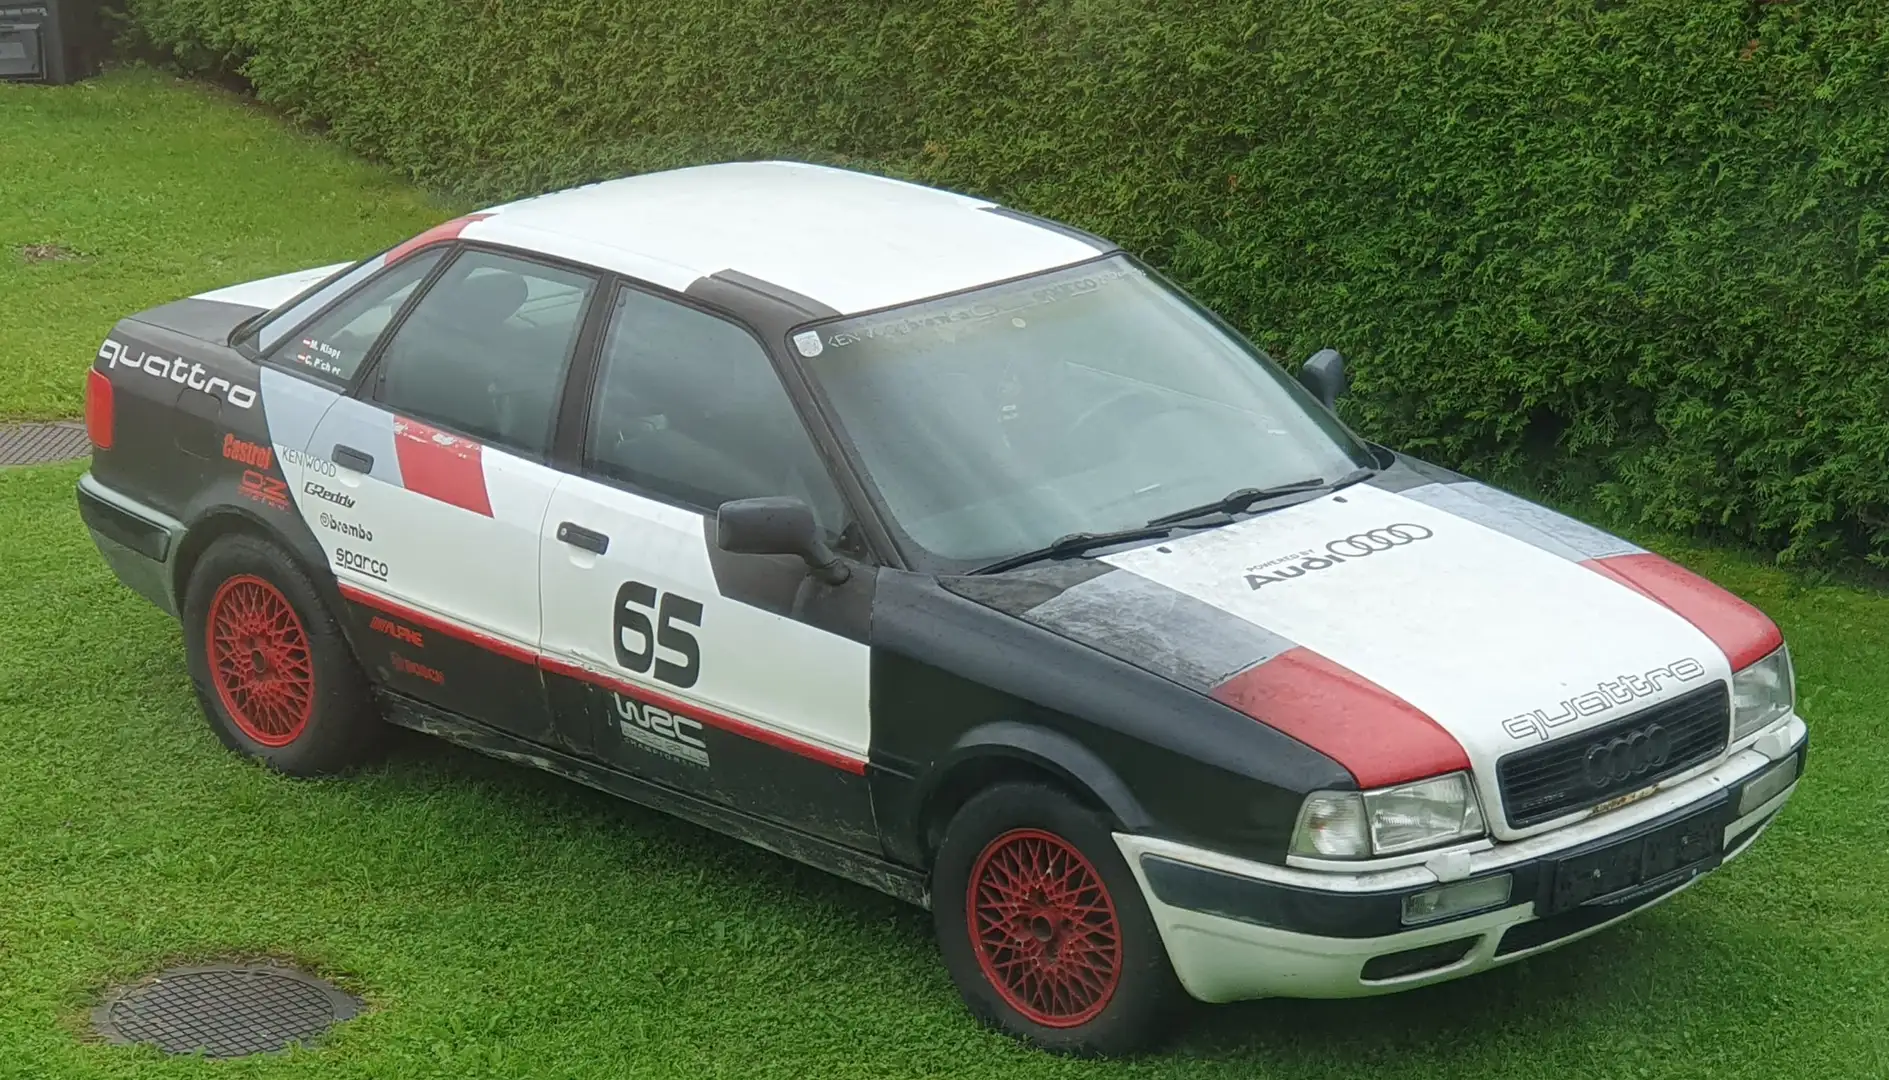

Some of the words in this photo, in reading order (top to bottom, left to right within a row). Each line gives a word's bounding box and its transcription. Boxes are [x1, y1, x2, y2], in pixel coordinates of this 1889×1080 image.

[98, 339, 257, 409] quattro
[223, 432, 273, 470] Castrol
[328, 513, 374, 542] brembo
[335, 547, 389, 579] sparco
[1243, 554, 1346, 591] Audi
[613, 580, 704, 689] 65
[614, 691, 707, 749] WRC
[1502, 657, 1705, 741] quattro
